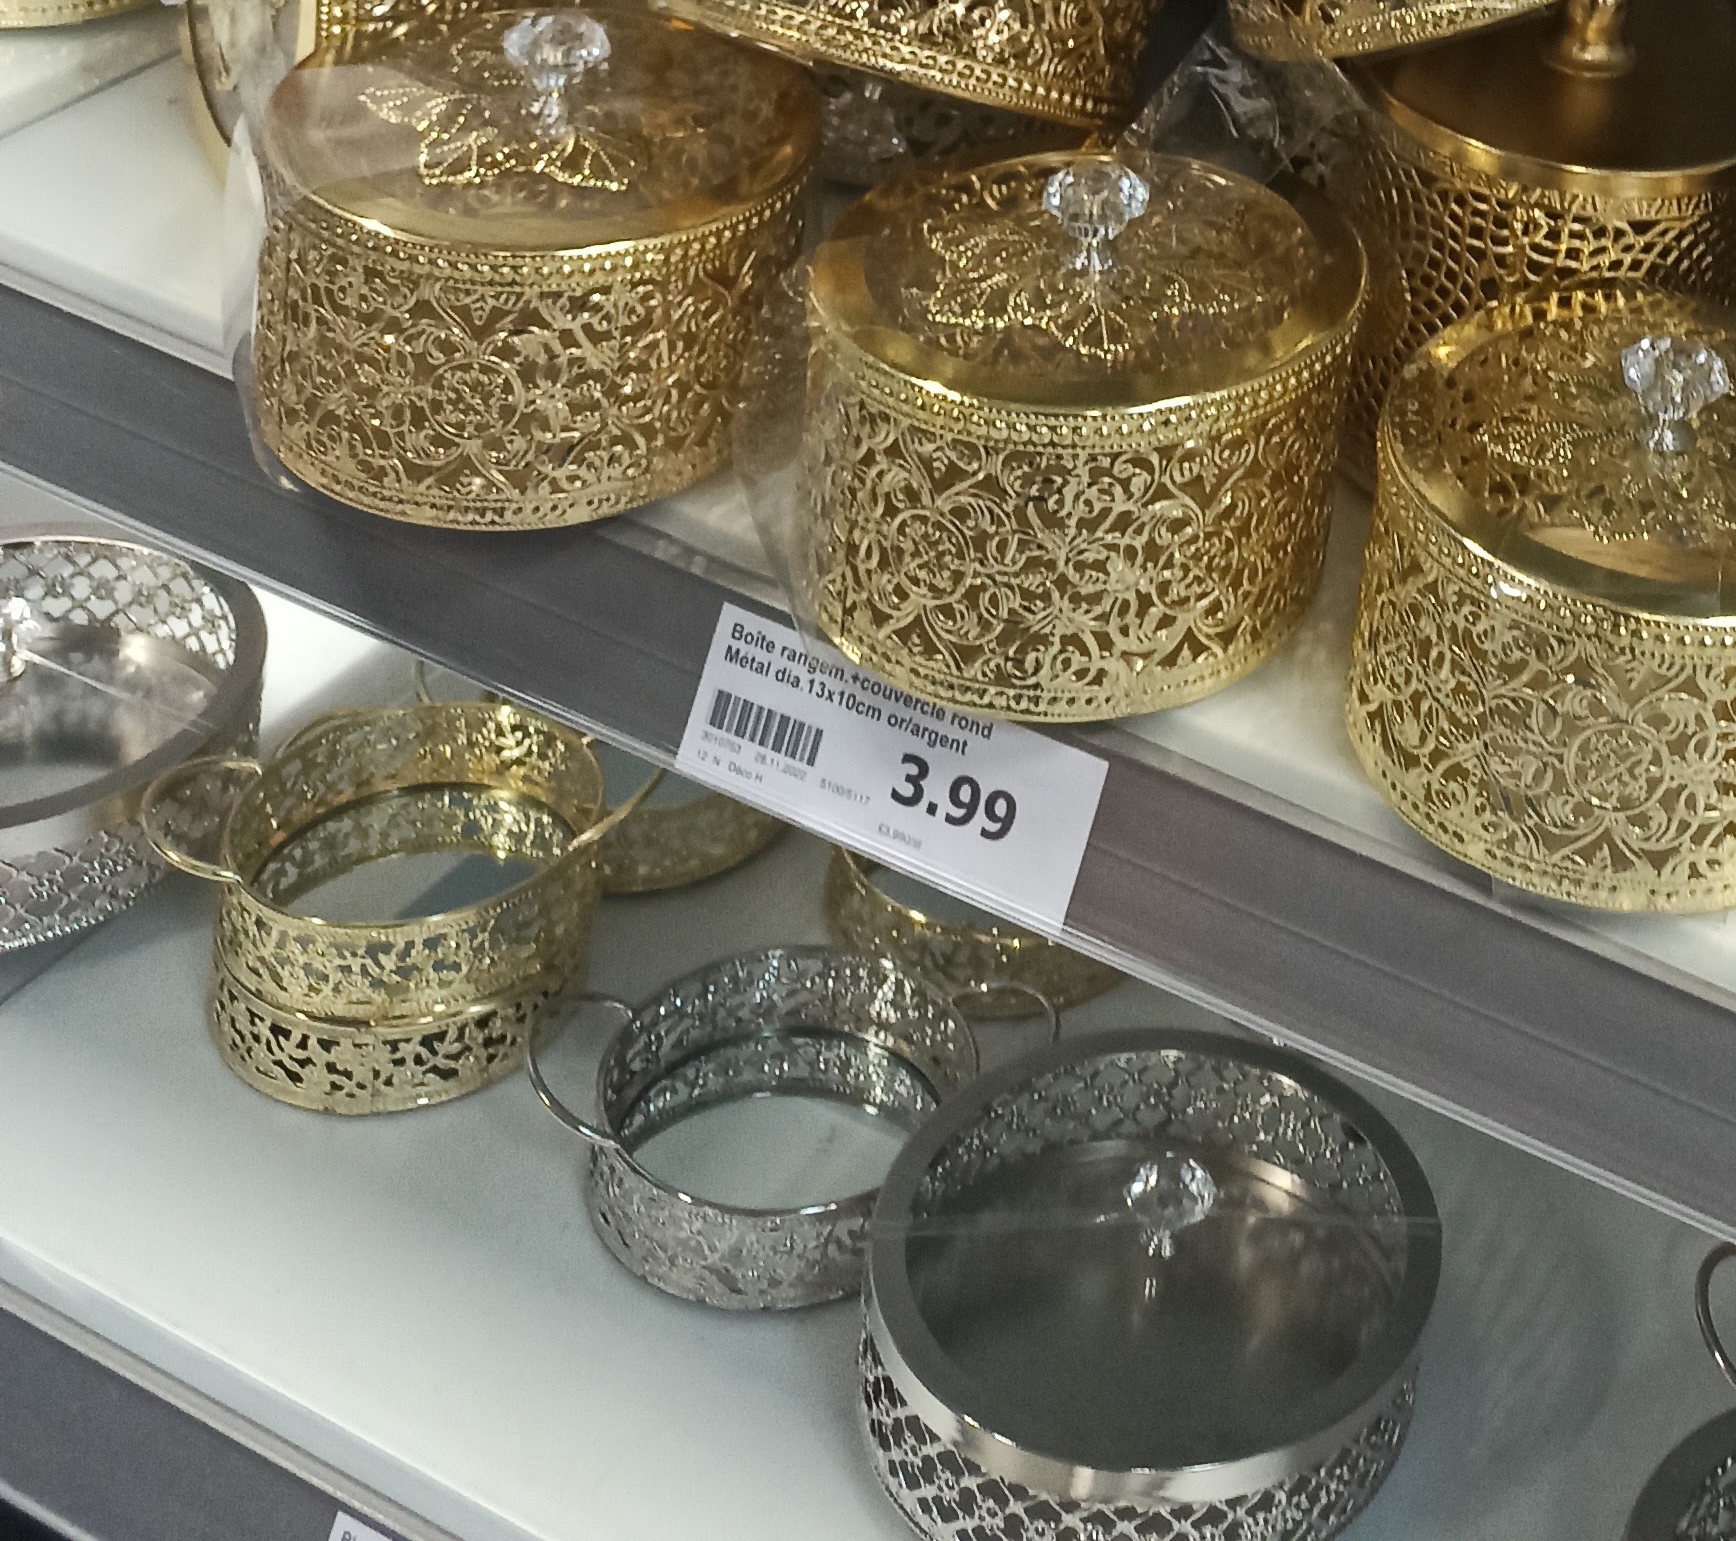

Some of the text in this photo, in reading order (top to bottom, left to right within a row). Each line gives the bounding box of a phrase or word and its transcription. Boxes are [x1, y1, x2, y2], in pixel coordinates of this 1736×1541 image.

[724, 644, 771, 678] Métal
[886, 713, 969, 756] or/argent
[731, 622, 994, 740] Boîte rangem.+couvercle rond
[890, 752, 1018, 841] 3.99
